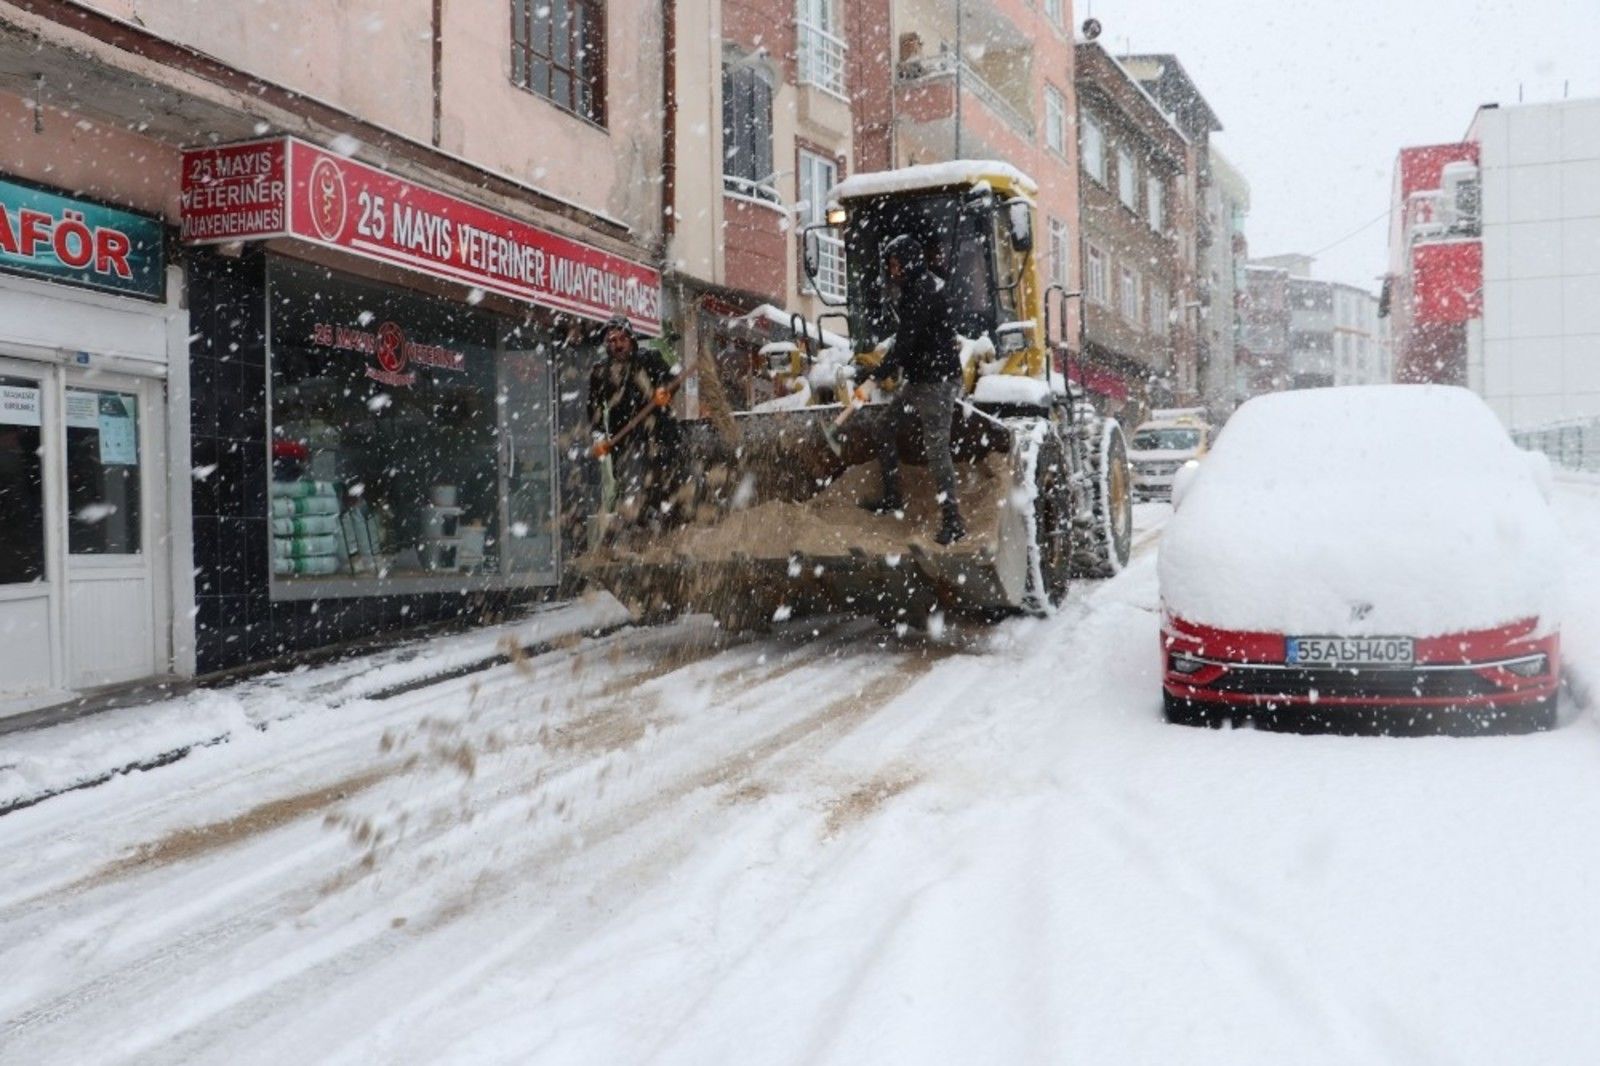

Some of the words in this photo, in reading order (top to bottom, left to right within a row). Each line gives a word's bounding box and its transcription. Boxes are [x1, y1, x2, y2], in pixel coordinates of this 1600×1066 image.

[192, 159, 213, 180] 25
[216, 152, 272, 177] MAYIS
[180, 180, 284, 210] VETERİNER
[180, 204, 283, 237] MUAYENEHANESİ
[357, 191, 386, 240] 25
[393, 202, 451, 260] MAYIS
[458, 223, 545, 287] VETERİNER
